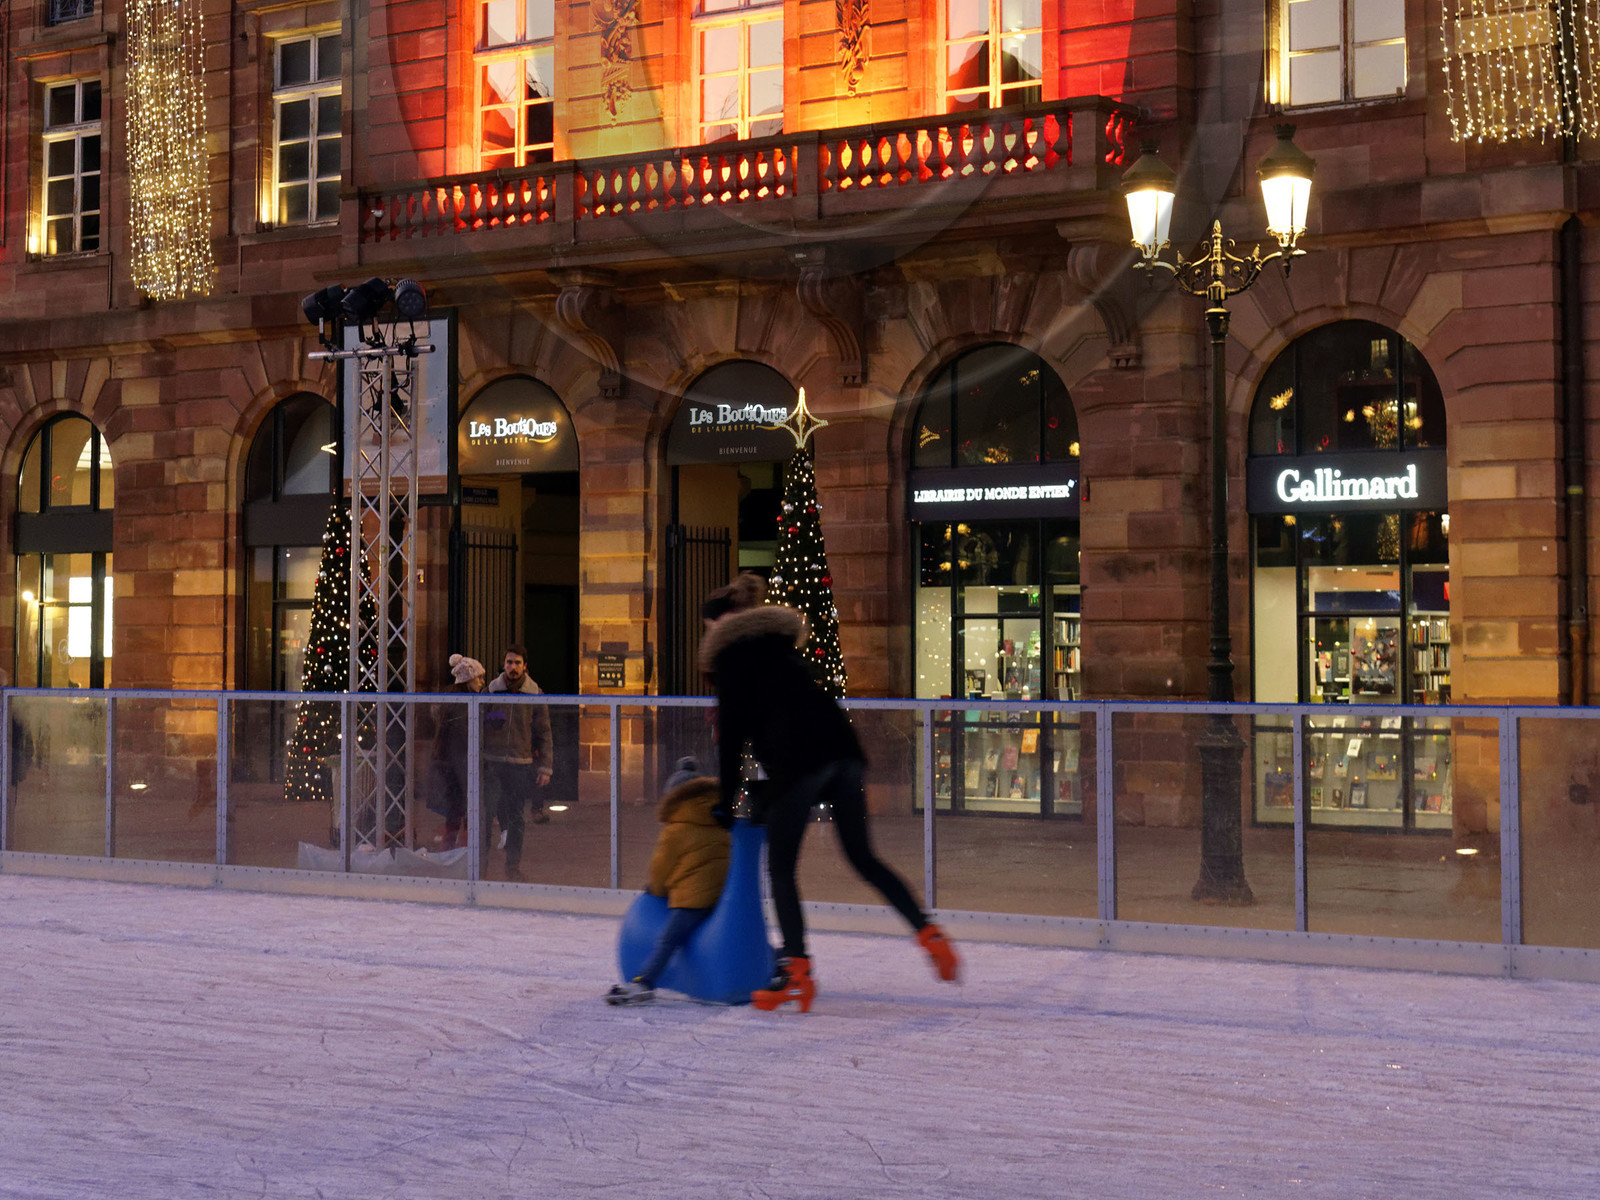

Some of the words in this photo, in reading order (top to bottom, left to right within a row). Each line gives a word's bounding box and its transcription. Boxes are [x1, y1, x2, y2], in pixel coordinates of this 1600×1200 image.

[707, 424, 755, 433] L'AUBETTE
[719, 446, 758, 455] BIENVENUE
[496, 458, 530, 466] BIENVENUE
[1276, 463, 1419, 502] Gallimard
[914, 489, 965, 502] LIBRAIRIE
[966, 488, 983, 501] DU
[984, 486, 1027, 500] MONDE
[1028, 484, 1070, 499] ENTIER
